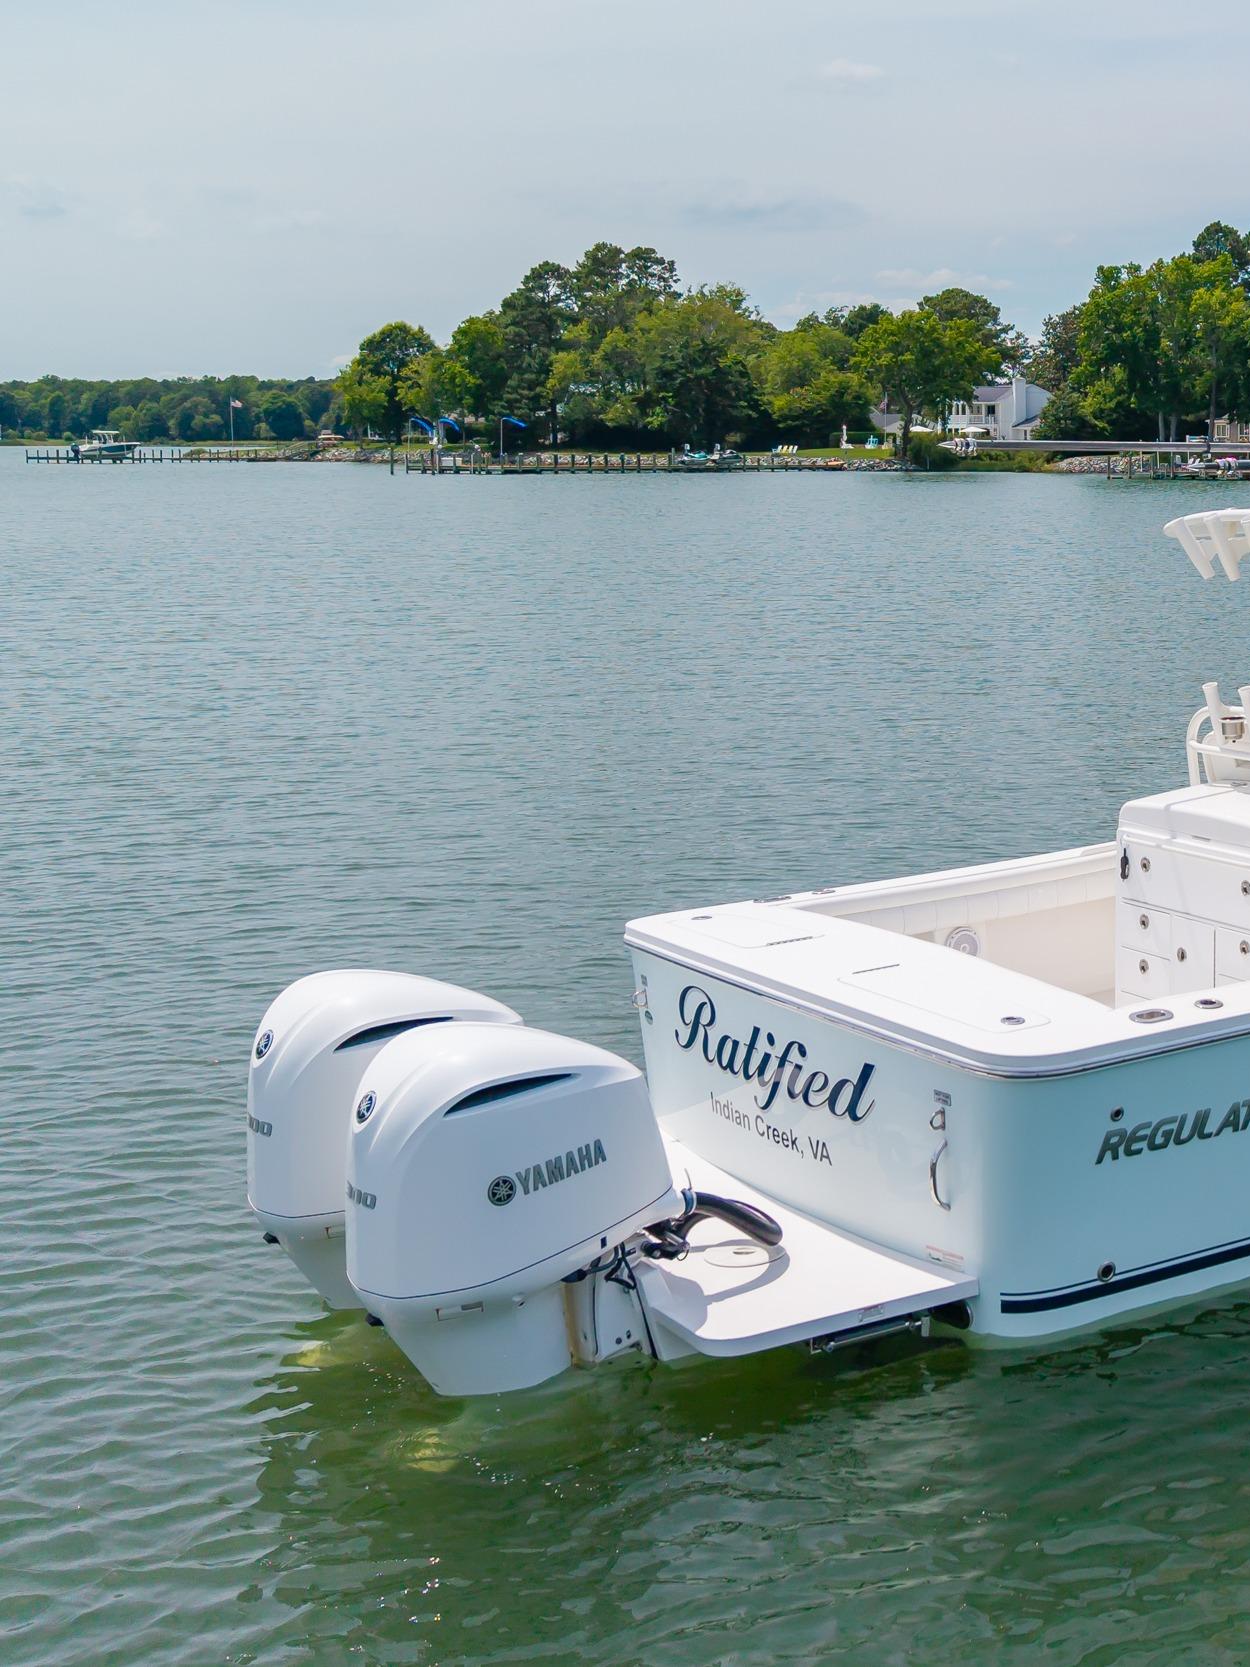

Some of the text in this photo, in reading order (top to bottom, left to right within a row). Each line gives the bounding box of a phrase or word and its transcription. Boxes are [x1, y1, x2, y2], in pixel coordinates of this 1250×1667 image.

[675, 985, 875, 1122] Ratified
[711, 1091, 833, 1166] Indian Creek, VA
[515, 1138, 607, 1195] YAMAHA
